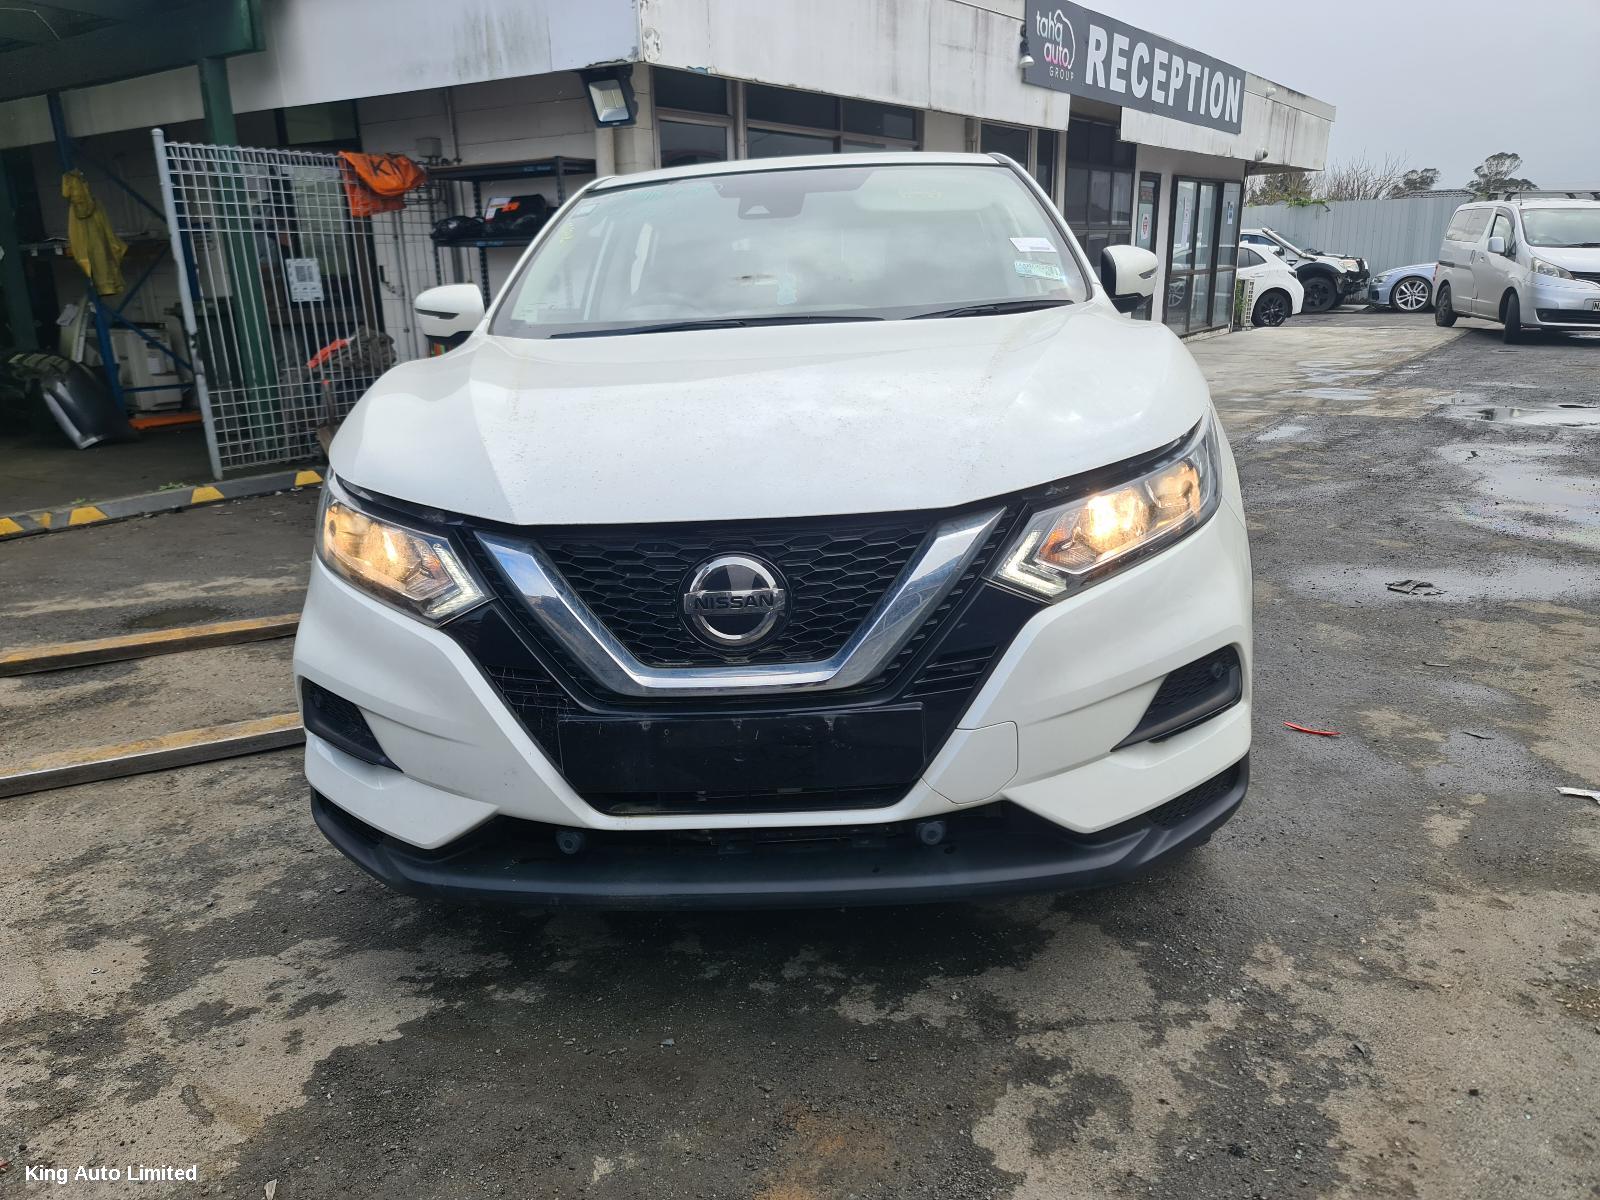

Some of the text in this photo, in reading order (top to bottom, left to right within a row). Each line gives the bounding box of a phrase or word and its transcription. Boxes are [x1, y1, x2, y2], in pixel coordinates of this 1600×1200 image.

[1036, 10, 1063, 43] taha
[1044, 42, 1070, 67] auto
[1049, 66, 1074, 81] GROUP
[1085, 24, 1241, 123] RECEPTION
[695, 593, 774, 610] NISSAN
